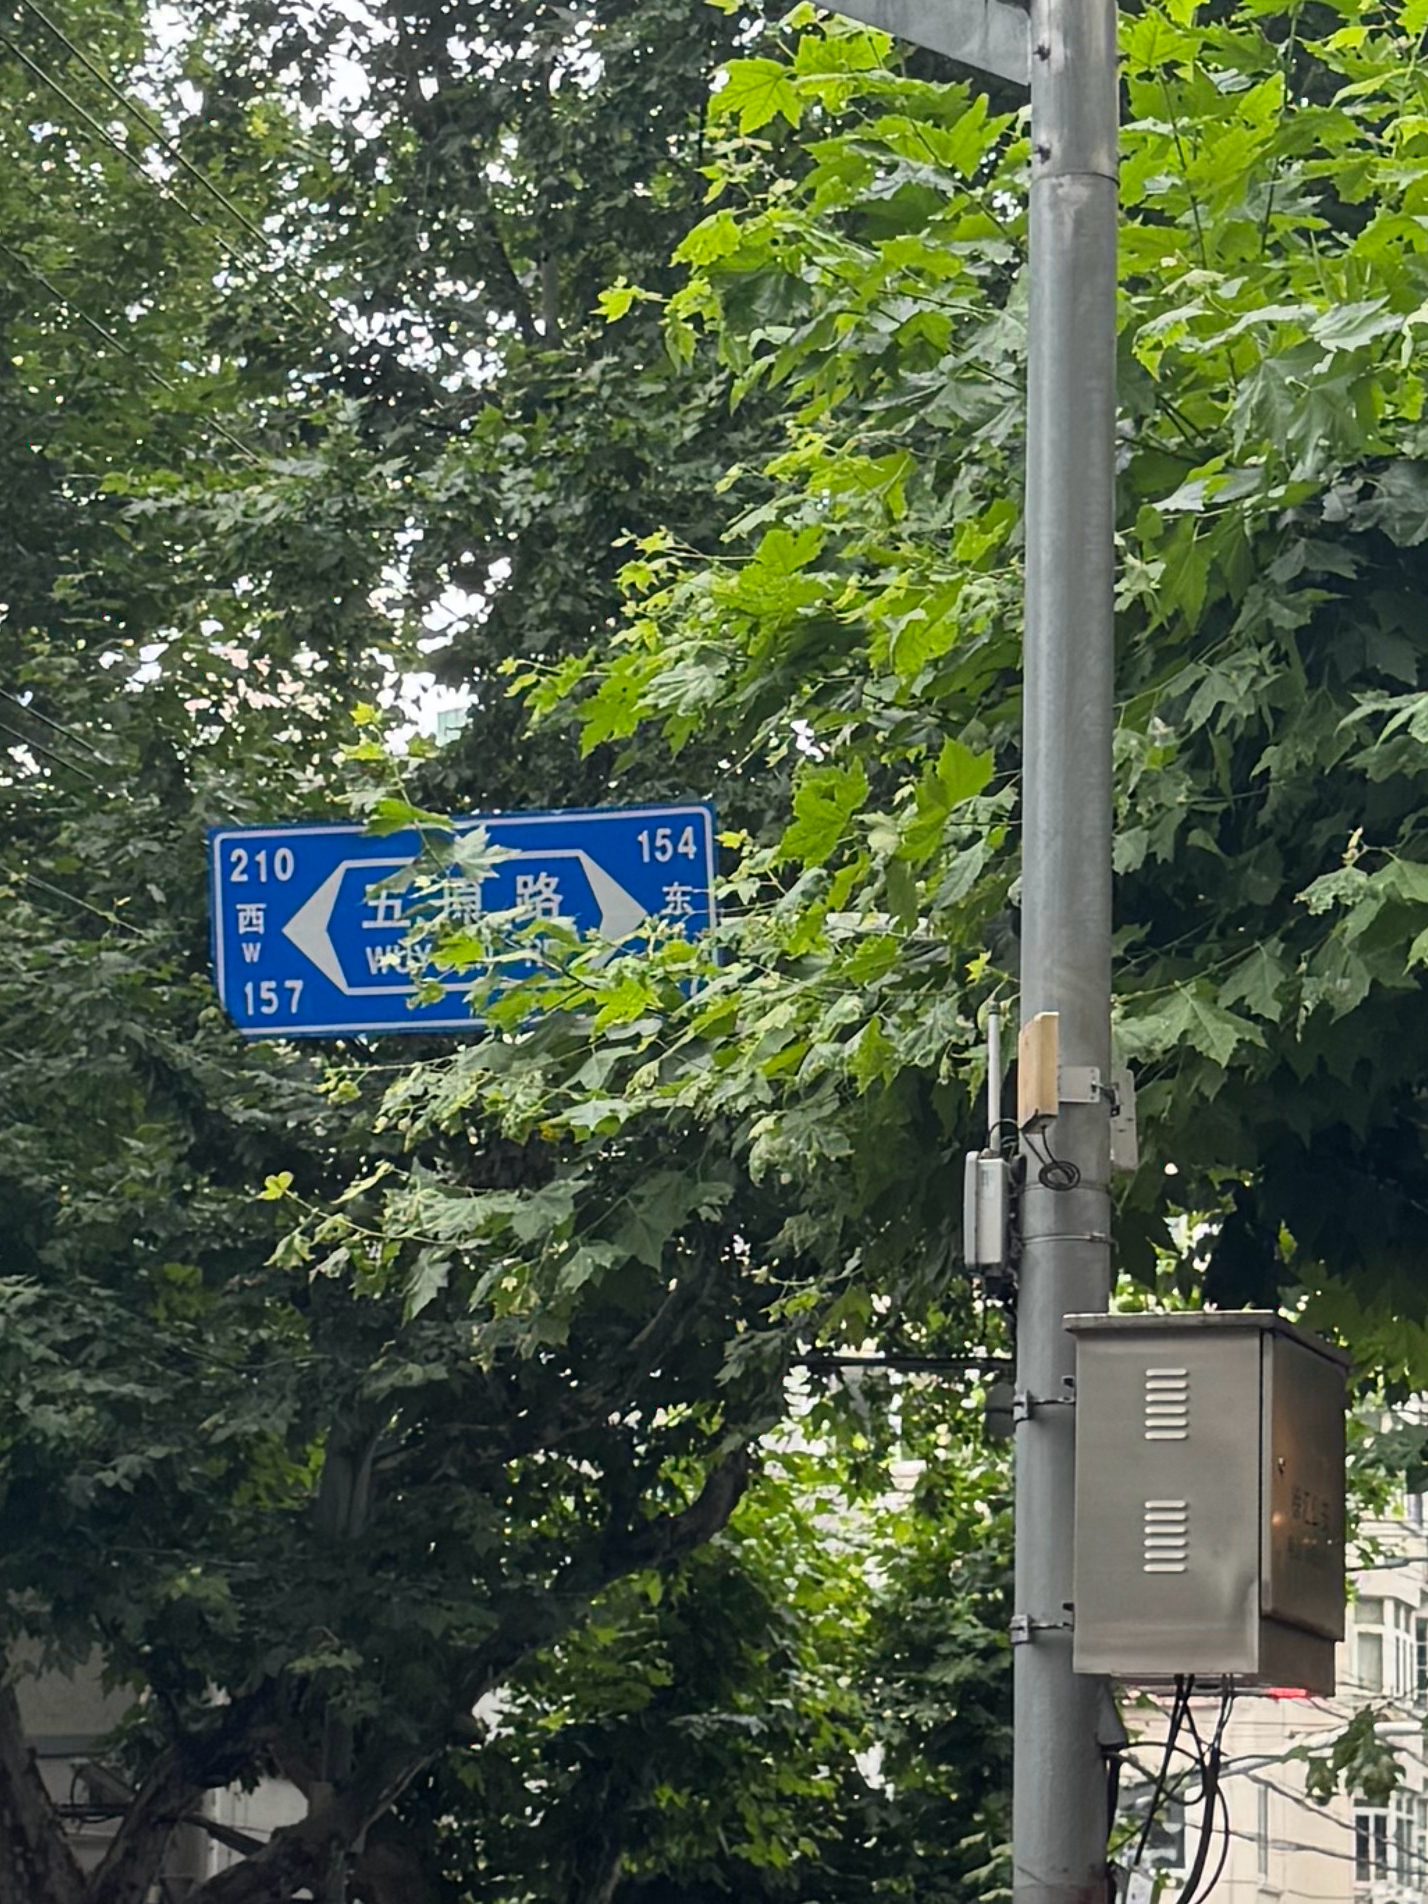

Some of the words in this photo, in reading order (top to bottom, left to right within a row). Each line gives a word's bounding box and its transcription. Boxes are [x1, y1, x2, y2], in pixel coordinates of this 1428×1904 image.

[637, 826, 697, 863] 154
[230, 848, 294, 882] 210
[361, 872, 564, 929] 五原路
[661, 881, 693, 915] 东
[236, 903, 267, 935] 西
[241, 942, 261, 963] W
[244, 979, 303, 1016] 157
